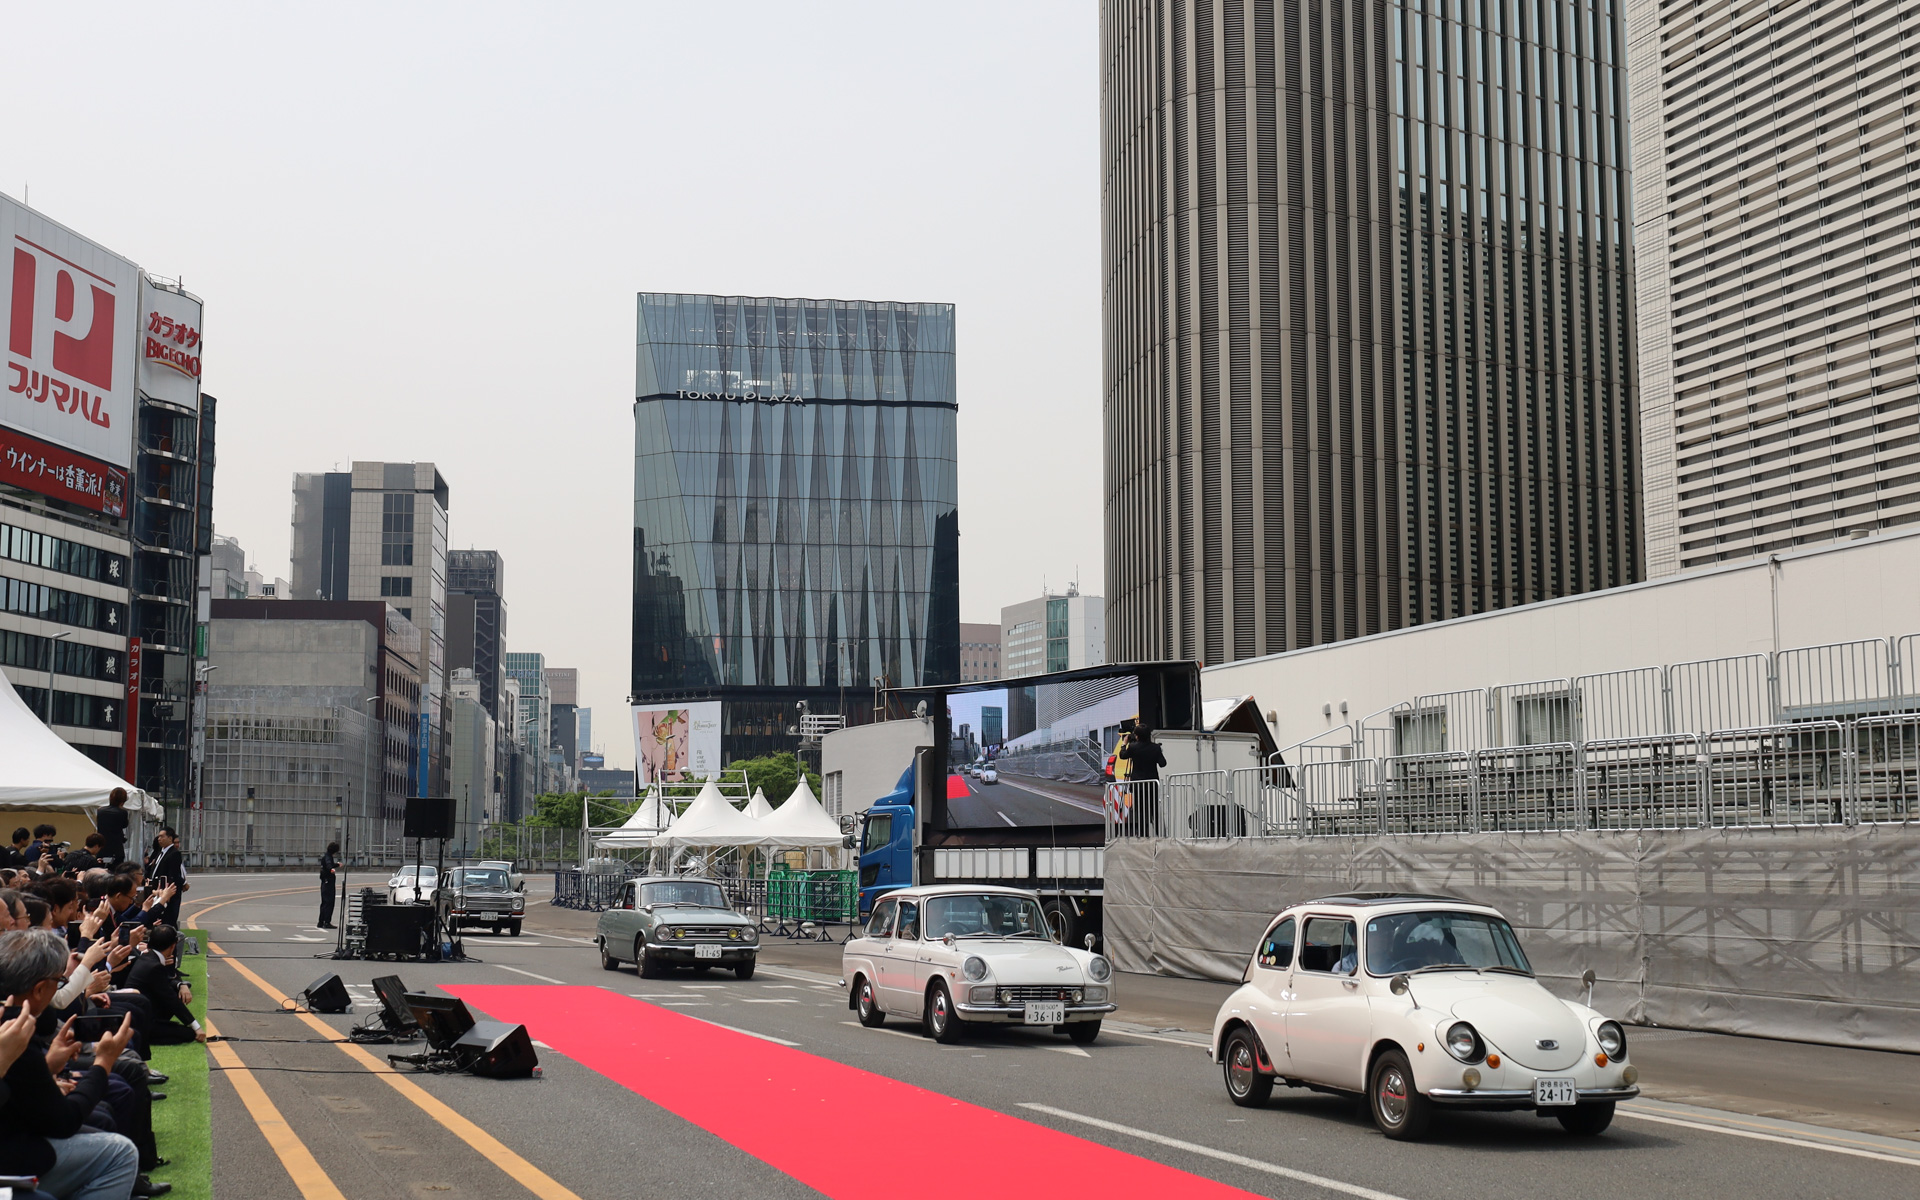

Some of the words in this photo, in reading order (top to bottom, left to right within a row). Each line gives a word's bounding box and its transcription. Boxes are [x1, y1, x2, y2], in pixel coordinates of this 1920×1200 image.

[148, 311, 200, 348] カラオケ
[8, 360, 110, 429] プリマハム
[676, 389, 736, 401] TOKYU
[743, 391, 804, 403] PLAZA
[129, 645, 140, 694] カラオケ
[1033, 1011, 1062, 1022] 36-18
[1539, 1089, 1573, 1102] 24-17
